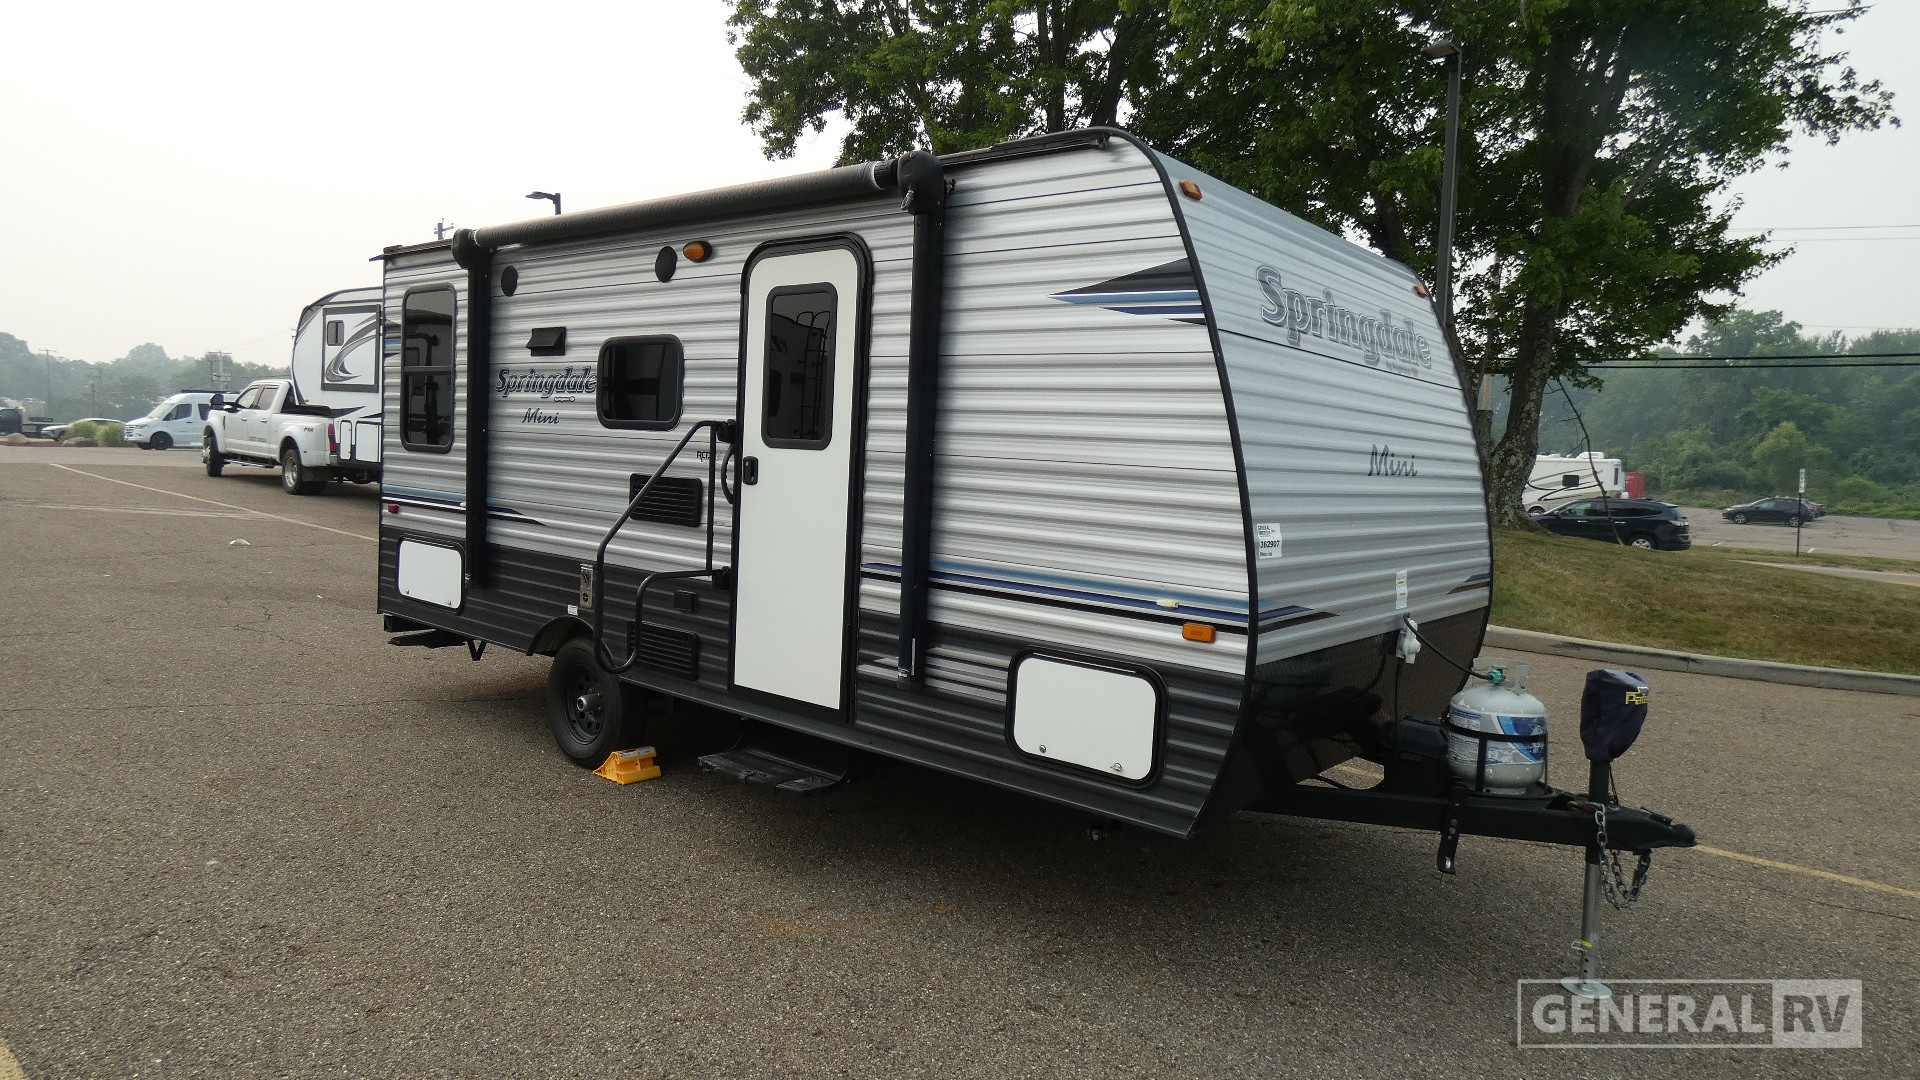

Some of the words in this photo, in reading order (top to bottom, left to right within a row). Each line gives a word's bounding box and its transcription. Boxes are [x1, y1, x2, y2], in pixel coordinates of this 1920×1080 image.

[1256, 265, 1432, 369] Springdale
[495, 366, 598, 398] Springdale
[522, 407, 560, 424] Mini
[1367, 443, 1418, 476] Mini
